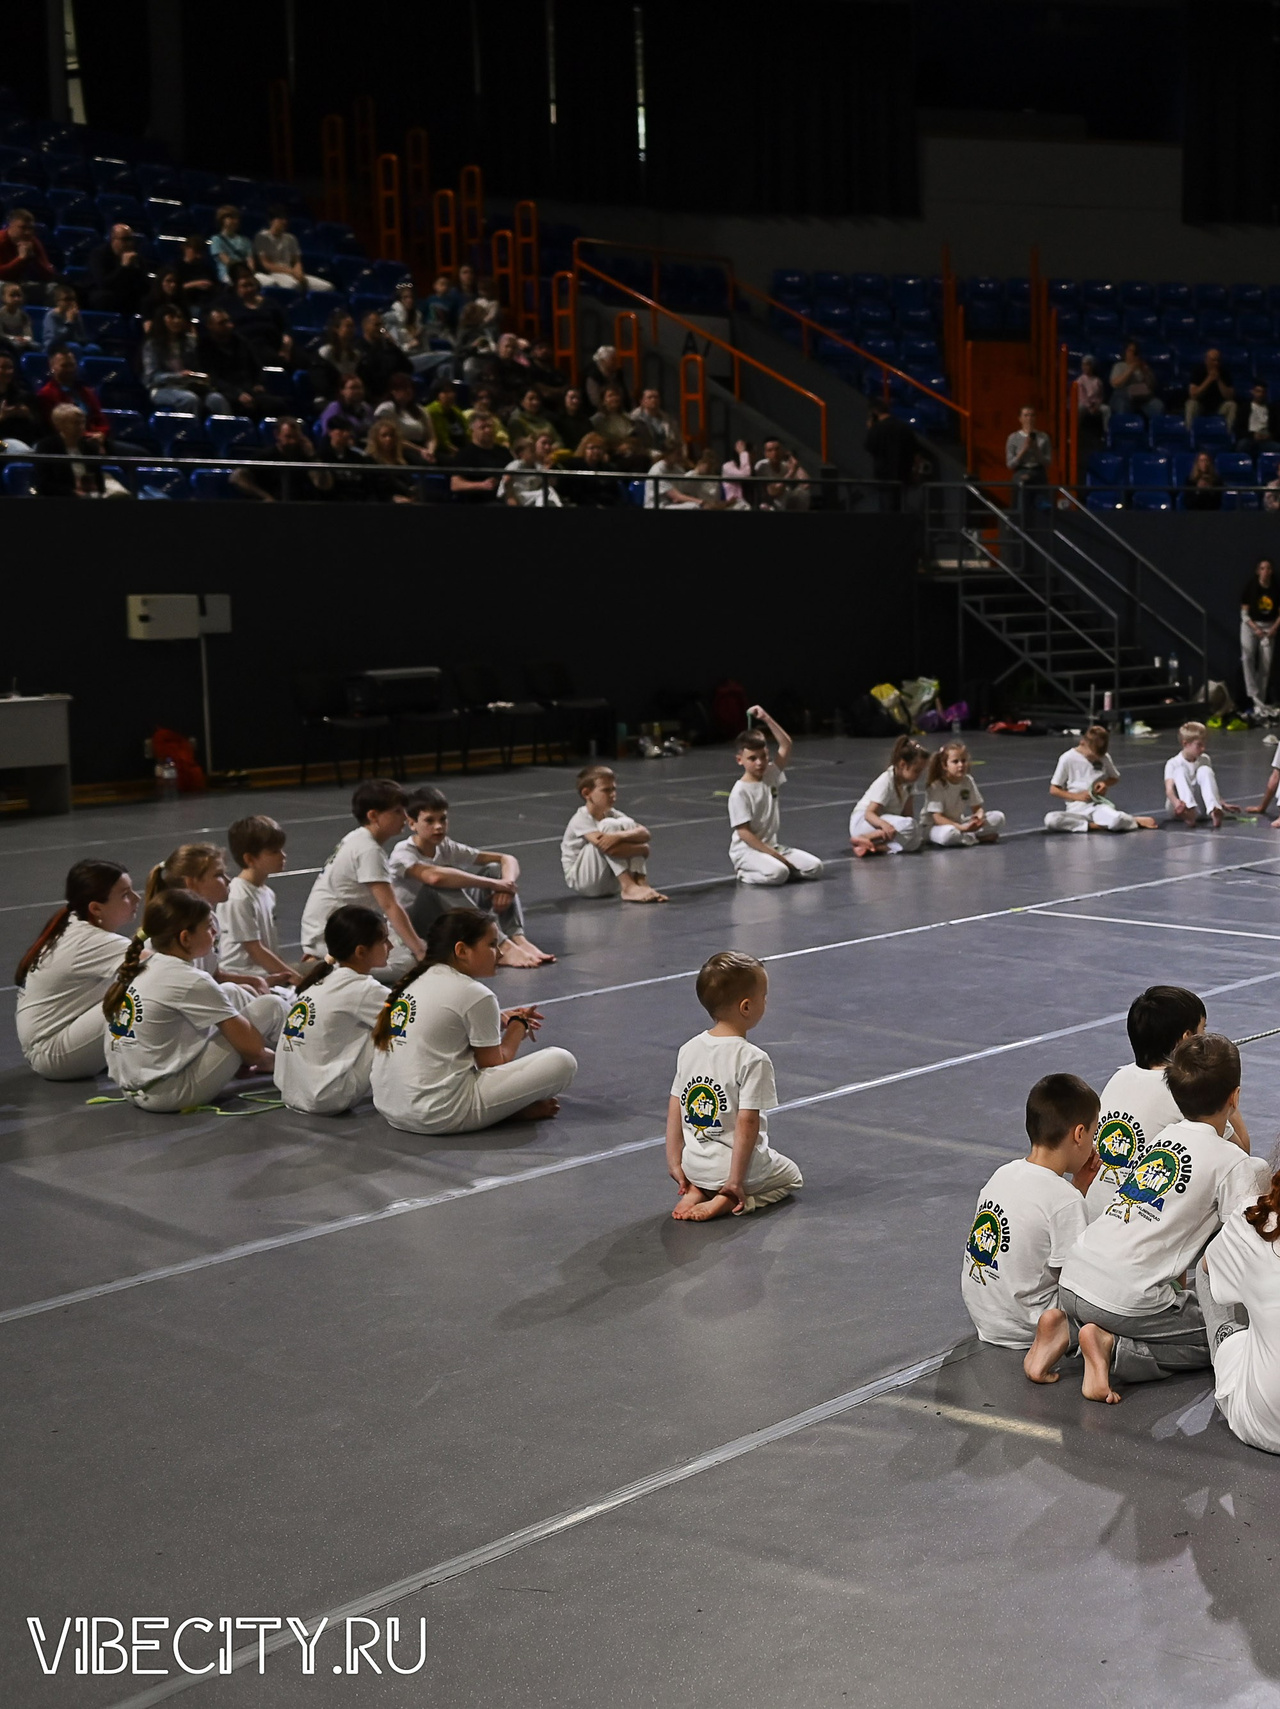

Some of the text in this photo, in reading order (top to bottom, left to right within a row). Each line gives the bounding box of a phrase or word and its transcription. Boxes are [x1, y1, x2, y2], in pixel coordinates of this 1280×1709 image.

[704, 1076, 714, 1086] DE
[713, 1084, 727, 1111] OURO
[1122, 1112, 1134, 1123] DE
[1133, 1122, 1145, 1152] OURO
[1171, 1141, 1187, 1155] DE
[1174, 1154, 1192, 1194] OURO
[993, 1204, 1010, 1253] DE OURO
